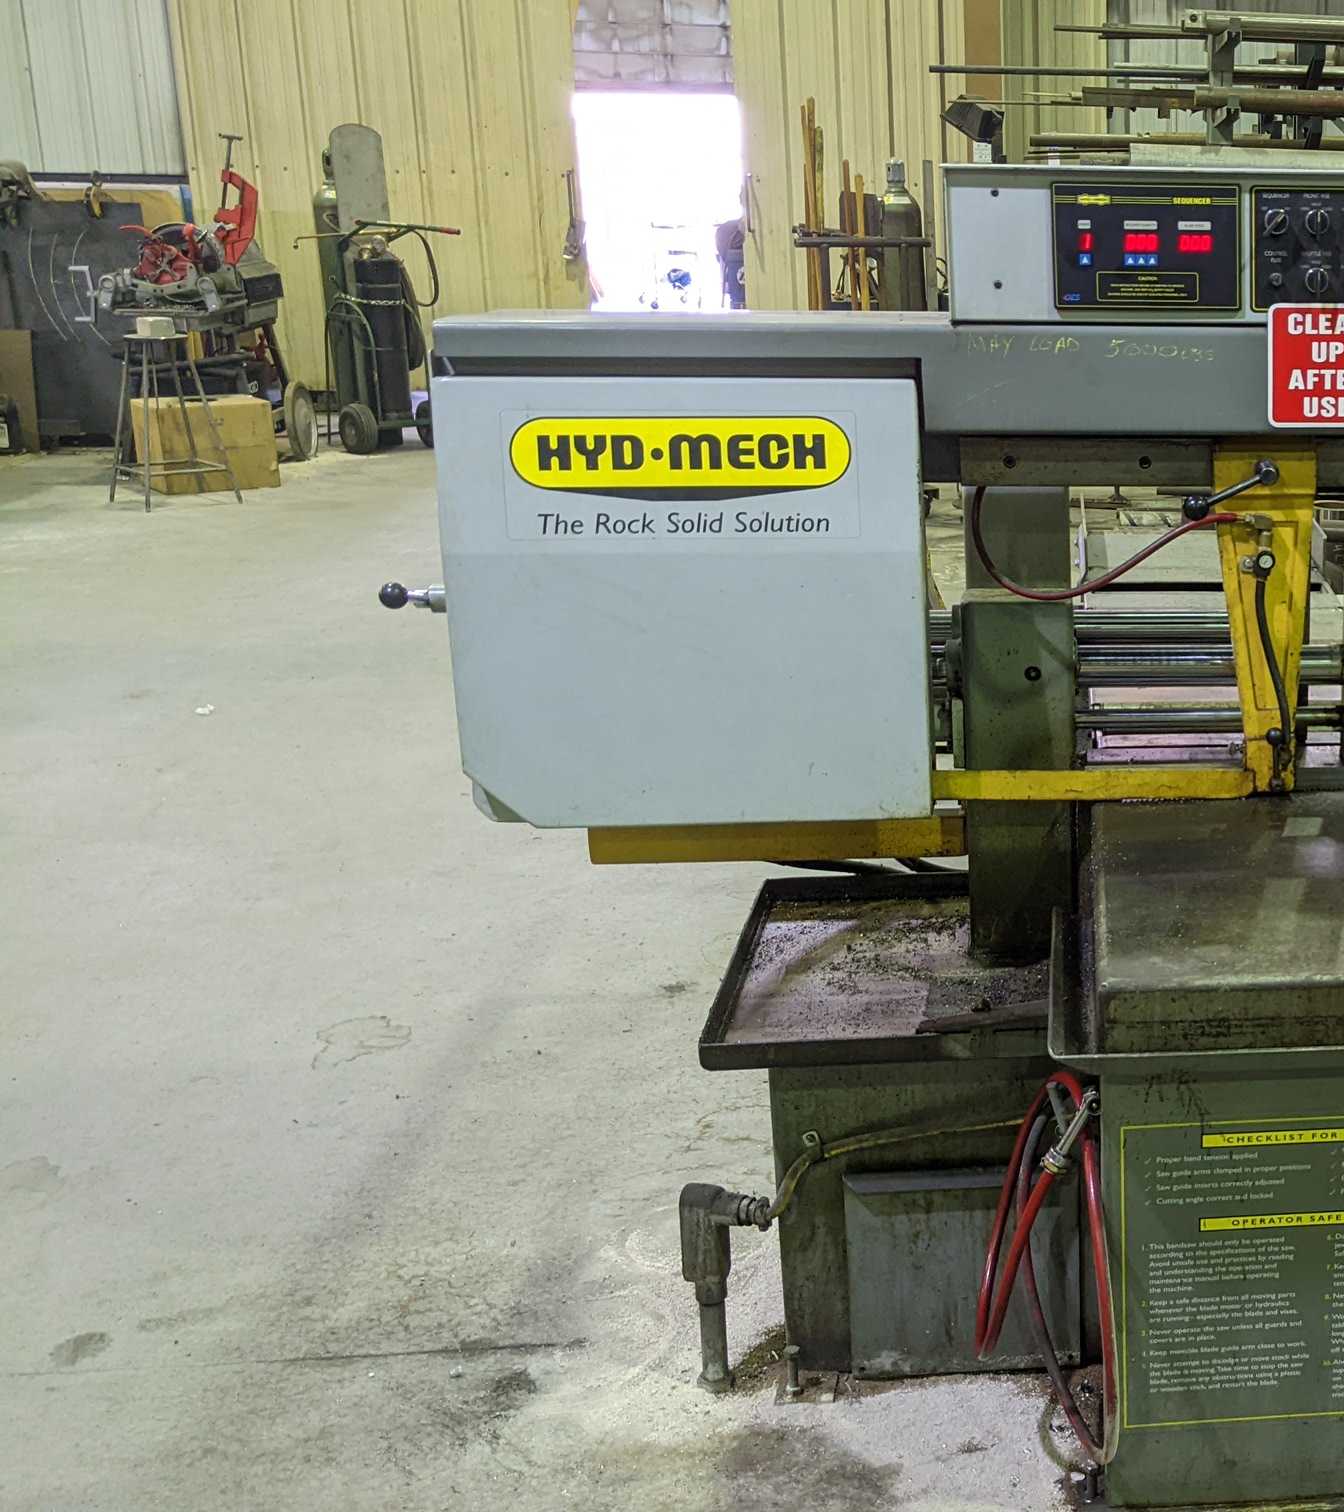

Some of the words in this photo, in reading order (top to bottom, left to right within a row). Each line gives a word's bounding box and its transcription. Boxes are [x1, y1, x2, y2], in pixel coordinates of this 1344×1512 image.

[1311, 342, 1344, 362] UP
[537, 513, 584, 534] The
[595, 512, 656, 535] Rock
[666, 512, 724, 534] Solid
[734, 512, 830, 534] Solution
[1226, 1133, 1304, 1143] CHECKLIST
[1312, 1131, 1337, 1140] FOR
[1231, 1216, 1303, 1226] OPERATOR
